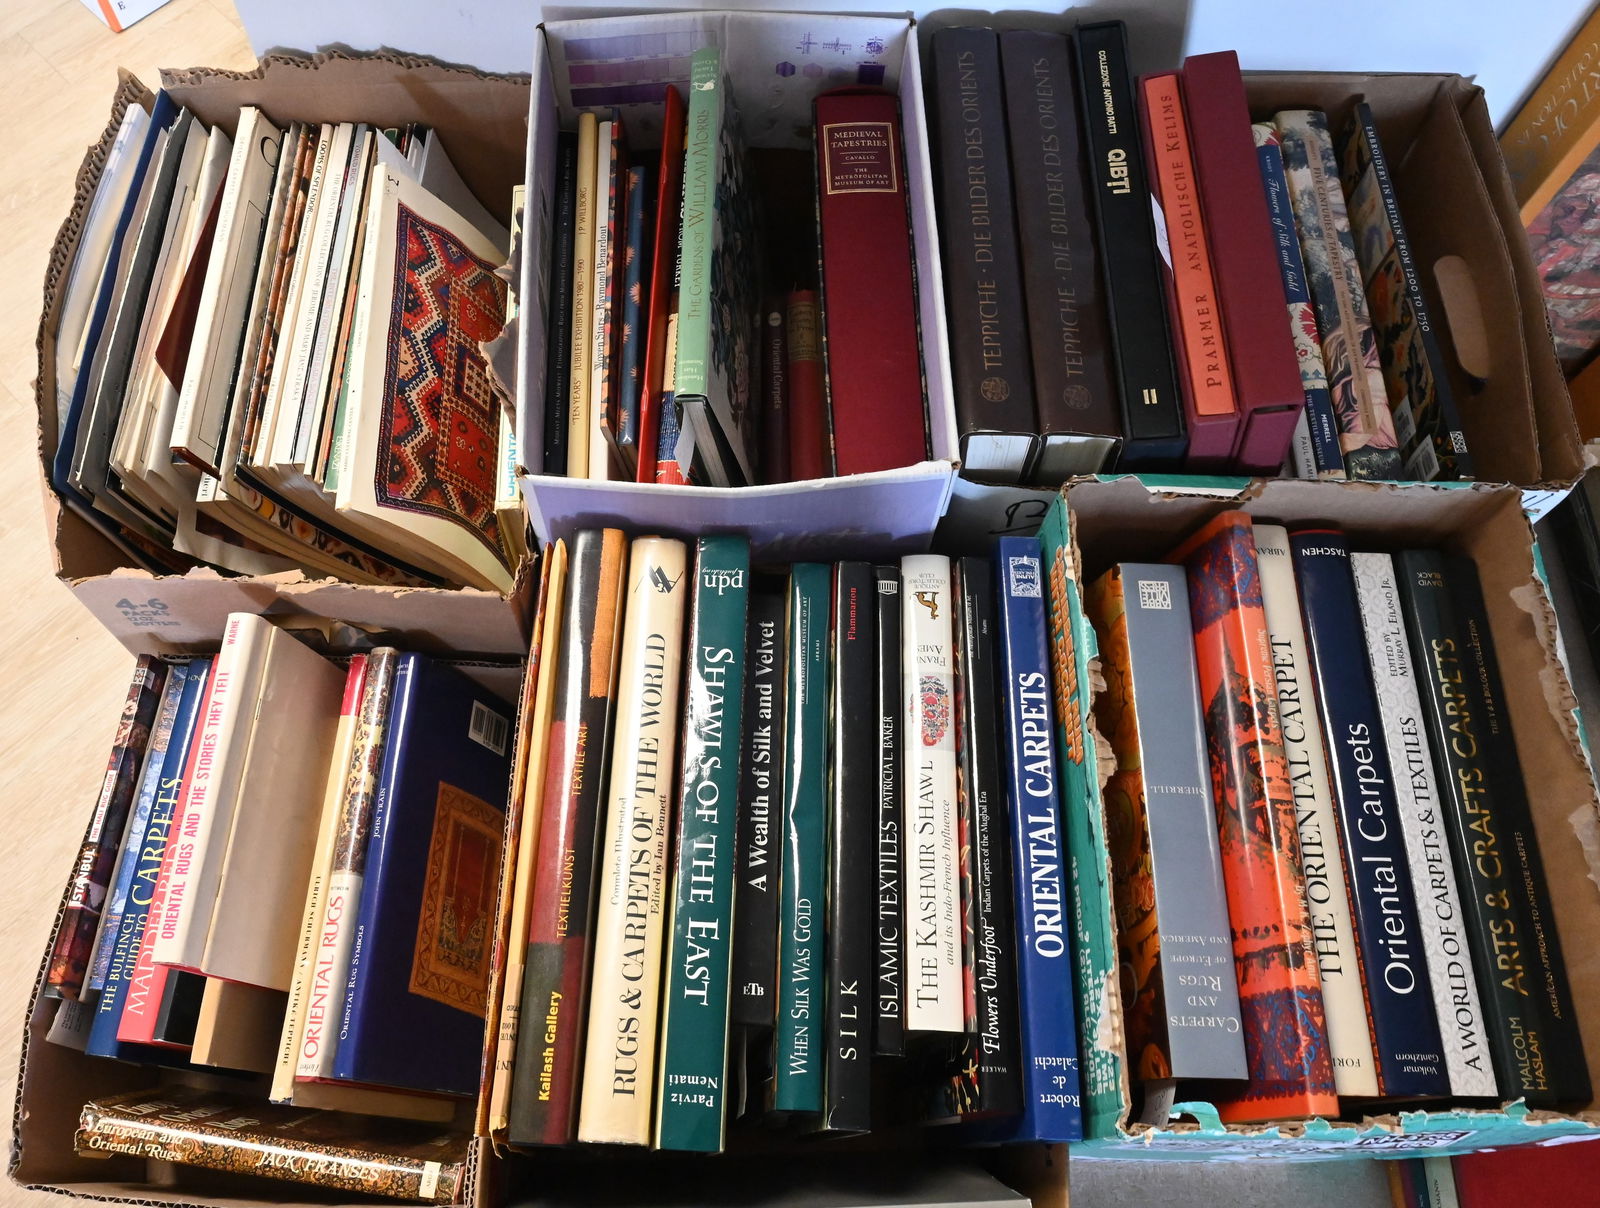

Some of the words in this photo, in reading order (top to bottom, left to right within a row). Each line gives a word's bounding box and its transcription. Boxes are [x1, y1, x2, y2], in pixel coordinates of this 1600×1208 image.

[957, 51, 982, 123] ORIENTS
[1098, 50, 1111, 88] COLLEZIONE
[1032, 57, 1057, 130] ORIENTS
[1103, 88, 1114, 117] ANTONIO
[691, 109, 710, 158] MORRIS
[834, 130, 883, 139] MEDIEVAL
[1107, 115, 1118, 134] RATTI
[1160, 95, 1180, 153] KELIMS
[316, 139, 328, 164] LOOMS
[830, 139, 888, 149] TAPESTRIES
[965, 127, 983, 160] DES
[1041, 134, 1061, 167] DES
[1365, 126, 1387, 182] EMBROIDERY
[314, 164, 322, 174] OF
[578, 187, 587, 223] WILLBORG
[687, 159, 707, 227] WILLIAM
[967, 165, 991, 226] BILDER
[1046, 172, 1069, 235] BILDER
[1268, 178, 1280, 214] Flowers
[1382, 184, 1391, 196] IN
[1173, 160, 1202, 272] ANATOLISCHE
[1272, 213, 1282, 230] of
[1386, 198, 1402, 235] BRITAIN
[596, 225, 606, 270] Benardout
[973, 231, 993, 263] DIE
[1052, 241, 1073, 272] DIE
[1283, 249, 1295, 270] and
[1397, 238, 1411, 264] FROM
[688, 245, 703, 295] GARDENS
[1405, 266, 1419, 292] 1200
[595, 270, 606, 310] Raymond
[687, 297, 701, 320] THE
[1413, 294, 1423, 307] TO
[574, 298, 584, 340] EXHIBITION
[594, 317, 604, 340] Stars
[977, 279, 1002, 370] TEPPICHE
[1057, 287, 1083, 377] TEPPICHE
[1417, 312, 1430, 333] 1750
[573, 341, 583, 370] JUBILEE
[1196, 294, 1222, 388] PRAMMER
[1320, 413, 1331, 443] MERRELL
[1302, 547, 1346, 557] TASCHEN
[704, 569, 744, 596] pdp
[115, 597, 169, 611] 4-6
[848, 587, 857, 641] Flammarion
[227, 619, 240, 646] WARNE
[755, 620, 774, 677] Velvet
[641, 633, 666, 729] WORLD
[1270, 634, 1306, 743] CARPET
[1431, 638, 1476, 759] CARPETS
[208, 696, 223, 727] THEY
[698, 646, 736, 769] SHAWLS
[755, 683, 772, 720] and
[752, 725, 771, 764] Silk
[883, 715, 893, 747] BAKER
[1019, 672, 1054, 797] CARPETS
[196, 733, 217, 780] STORIES
[635, 737, 659, 799] THE
[1399, 716, 1430, 805] TEXTILES
[190, 785, 207, 808] THE
[752, 767, 769, 789] of
[882, 764, 893, 809] PATRICIA
[979, 790, 987, 803] Era
[1150, 785, 1208, 799] SHERRILL
[1347, 722, 1387, 842] Carpets
[695, 781, 719, 825] OF
[913, 760, 935, 836] SHAWL
[1417, 807, 1435, 825] &
[184, 812, 200, 840] AND
[632, 806, 653, 843] OF
[749, 795, 770, 869] Wealth
[942, 799, 953, 848] Influence
[980, 803, 989, 831] Mughal
[1289, 750, 1331, 904] ORIENTAL
[1458, 767, 1502, 879] CRAFTS
[131, 777, 183, 906] CARPETS
[981, 831, 989, 847] the
[981, 847, 989, 857] of
[70, 848, 96, 907] ISTANBUL
[176, 843, 194, 875] RUGS
[689, 835, 718, 904] THE
[880, 821, 898, 921] TEXTILES
[981, 857, 991, 890] Carpets
[1420, 829, 1453, 921] CARPETS
[556, 848, 575, 938] TEXTIELKUNST
[748, 874, 767, 892] A
[915, 843, 937, 949] KASHMIR
[943, 854, 954, 922] Indo-French
[1028, 807, 1065, 959] ORIENTAL
[1485, 888, 1509, 910] &
[161, 880, 186, 940] ORIENTAL
[621, 849, 652, 983] CARPETS
[793, 897, 812, 943] GOLD
[983, 891, 991, 913] Indian
[1161, 935, 1207, 949] AMERICA
[1210, 935, 1229, 944] AND
[1361, 856, 1415, 995] Oriental
[1439, 925, 1460, 956] OF
[100, 986, 117, 1014] THE
[109, 913, 136, 982] BULFINCH
[352, 925, 365, 965] SYMBOLS
[683, 917, 720, 1006] EAST
[979, 916, 1001, 993] Underfoot
[1169, 954, 1213, 967] EUROPE
[1214, 955, 1228, 963] OF
[1313, 913, 1343, 982] THE
[1489, 919, 1529, 997] ARTS
[303, 955, 334, 1060] ORIENTAL
[322, 895, 345, 948] RUGS
[348, 966, 358, 988] RUG
[792, 948, 811, 982] WAS
[879, 926, 898, 1018] ISLAMIC
[916, 957, 939, 1009] THE
[1179, 975, 1222, 992] RUGS
[340, 990, 354, 1040] ORIENTAL
[619, 987, 642, 1010] &
[791, 987, 810, 1019] SILK
[1187, 996, 1218, 1007] AND
[1447, 963, 1478, 1051] WORLD
[545, 991, 562, 1044] Gallery
[981, 995, 1000, 1055] Flowers
[1170, 1016, 1239, 1034] CARPETS
[612, 1017, 640, 1099] RUGS
[789, 1025, 808, 1076] WHEN
[981, 1065, 1007, 1073] WALKER
[1395, 1052, 1439, 1063] Gantzhorn
[1465, 1055, 1482, 1072] A
[1508, 1016, 1535, 1091] MALCOLM
[1526, 1031, 1548, 1091] HASLAM
[538, 1045, 553, 1102] Kailash
[669, 1074, 718, 1089] Nemati
[1052, 1075, 1067, 1089] de
[1403, 1065, 1438, 1076] Volkmar
[671, 1092, 714, 1107] Parviz
[1041, 1094, 1081, 1109] Robert
[89, 1136, 142, 1155] Oriental
[144, 1144, 182, 1162] Rugs
[94, 1119, 155, 1143] European
[157, 1127, 185, 1145] and
[256, 1150, 301, 1175] JACK
[302, 1157, 380, 1181] FRANSES
